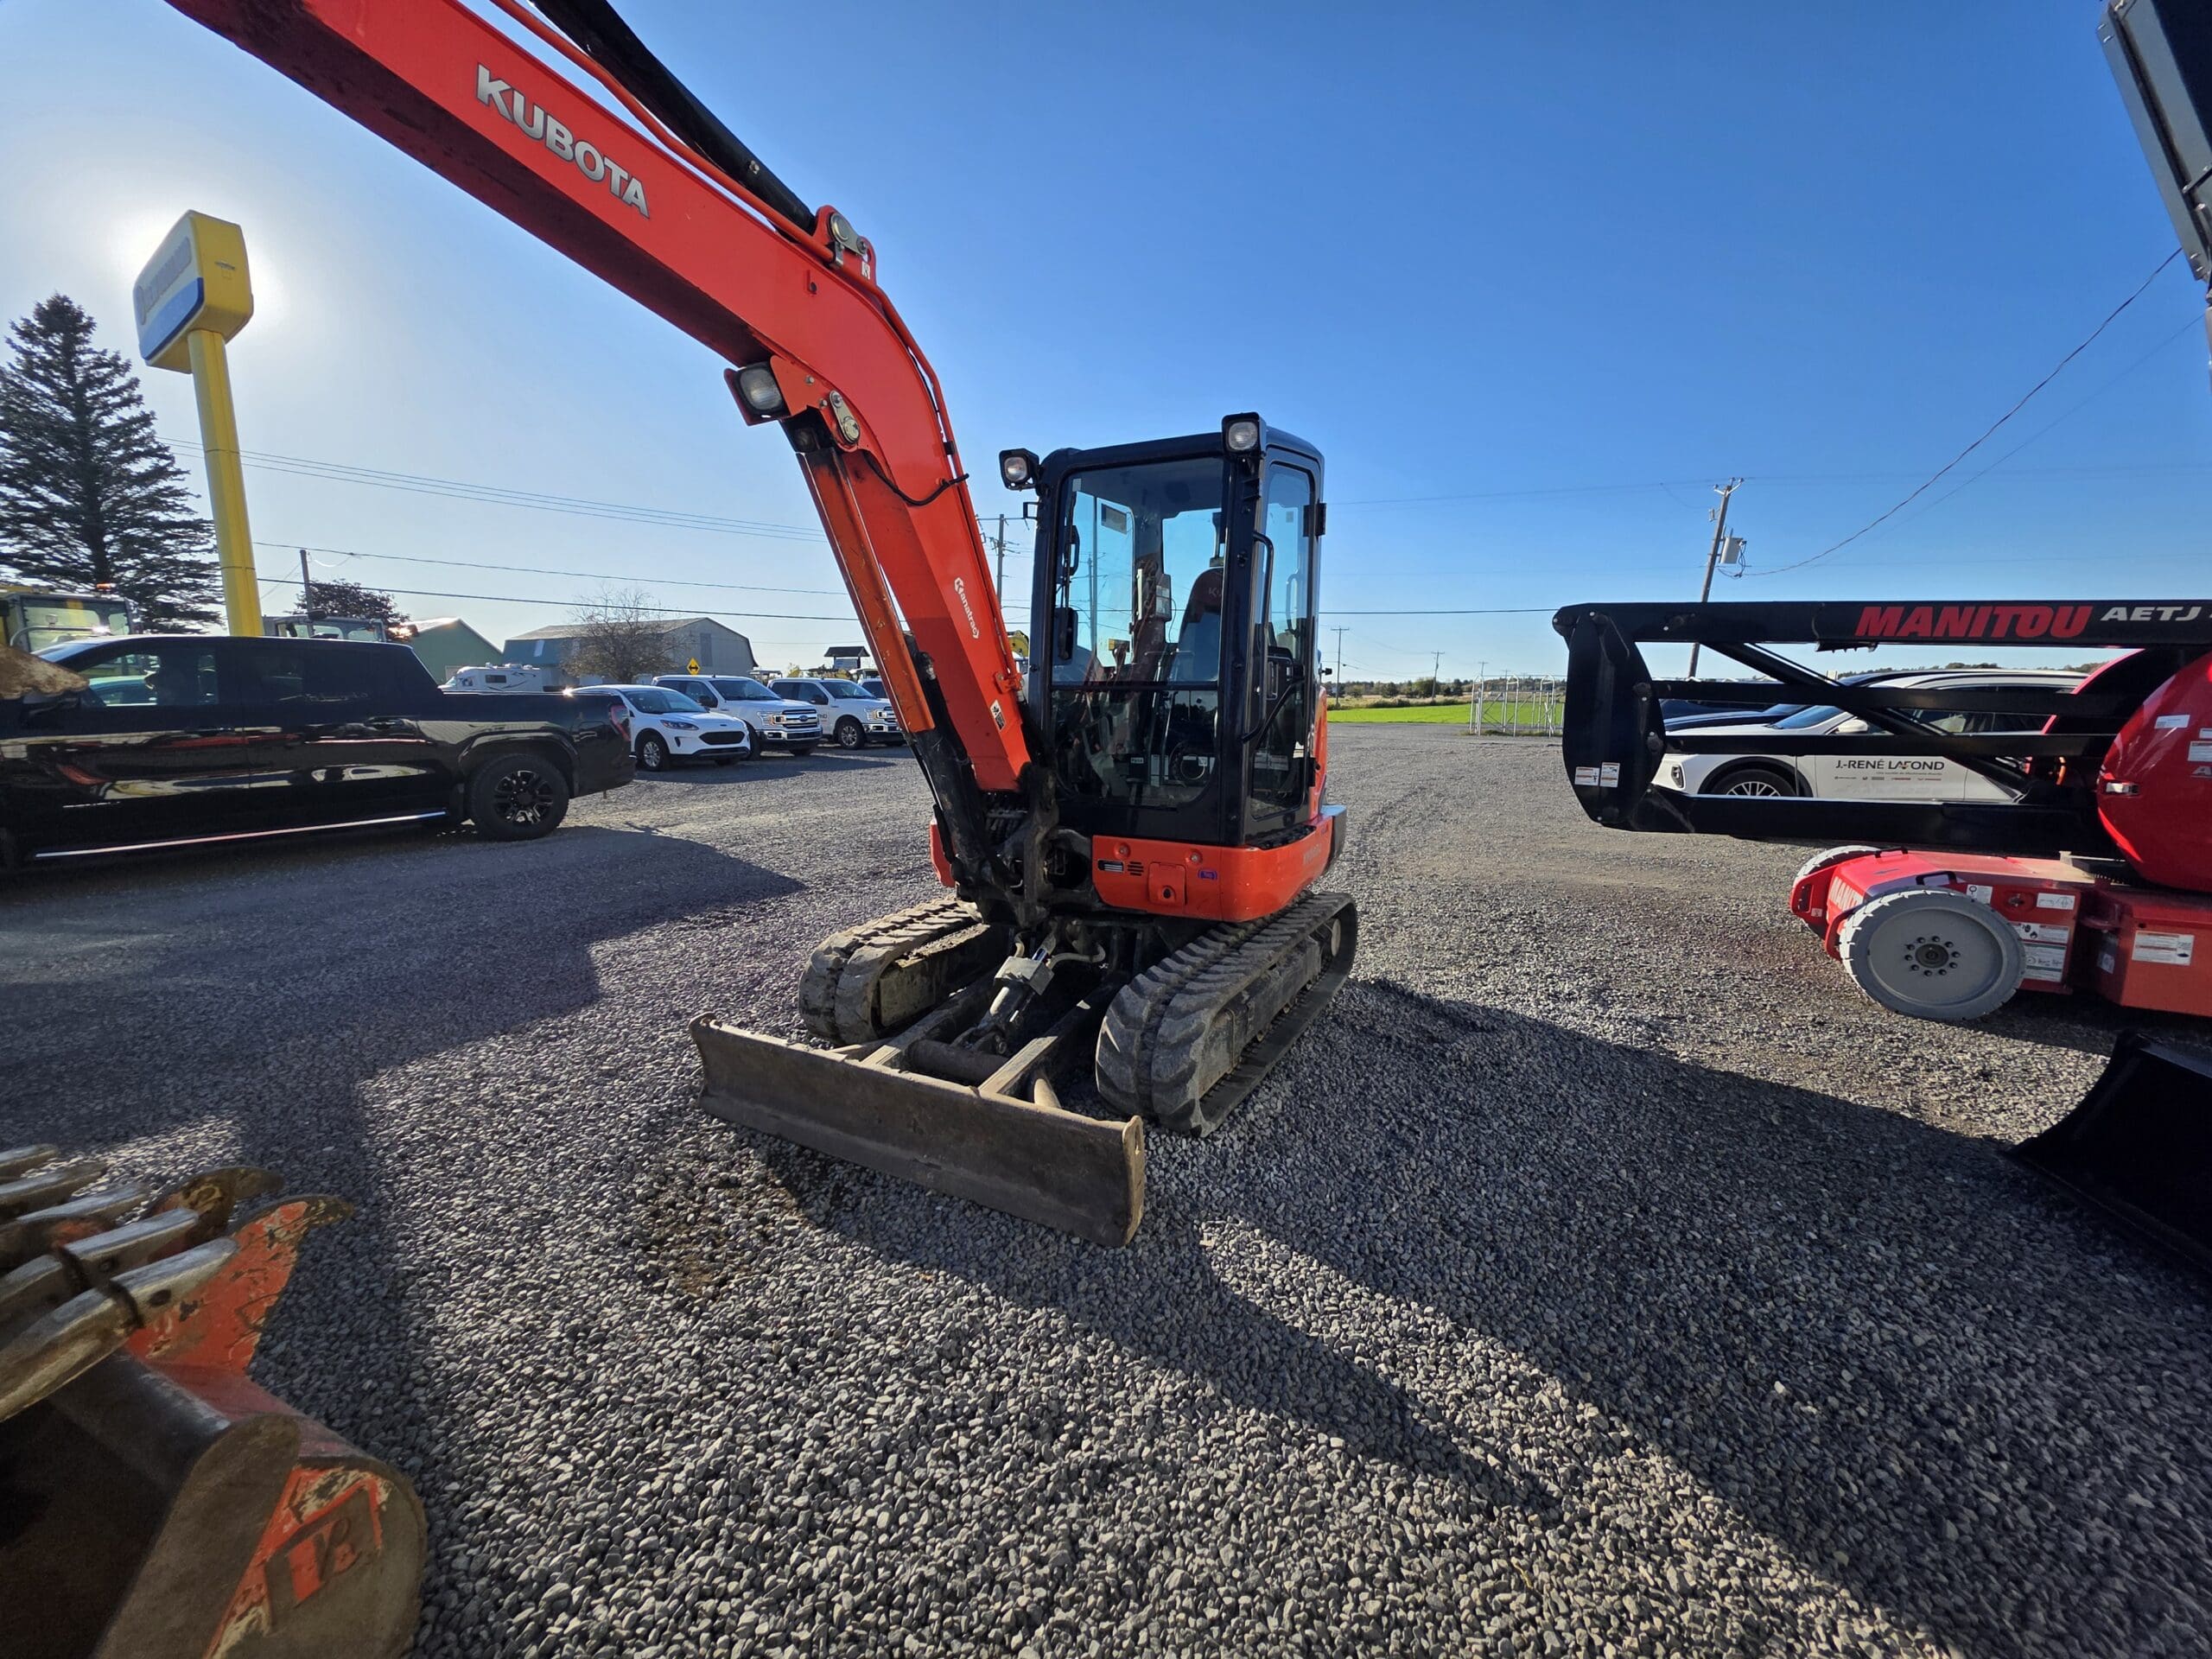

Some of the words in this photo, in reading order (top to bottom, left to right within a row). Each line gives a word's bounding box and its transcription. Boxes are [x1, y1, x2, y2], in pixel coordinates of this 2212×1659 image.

[476, 61, 650, 219] KUBOTA
[1855, 605, 2093, 639] MANITOU
[2100, 607, 2202, 621] AETJ
[1888, 760, 1945, 771] LAFOND
[1828, 875, 1864, 912] MANIT
